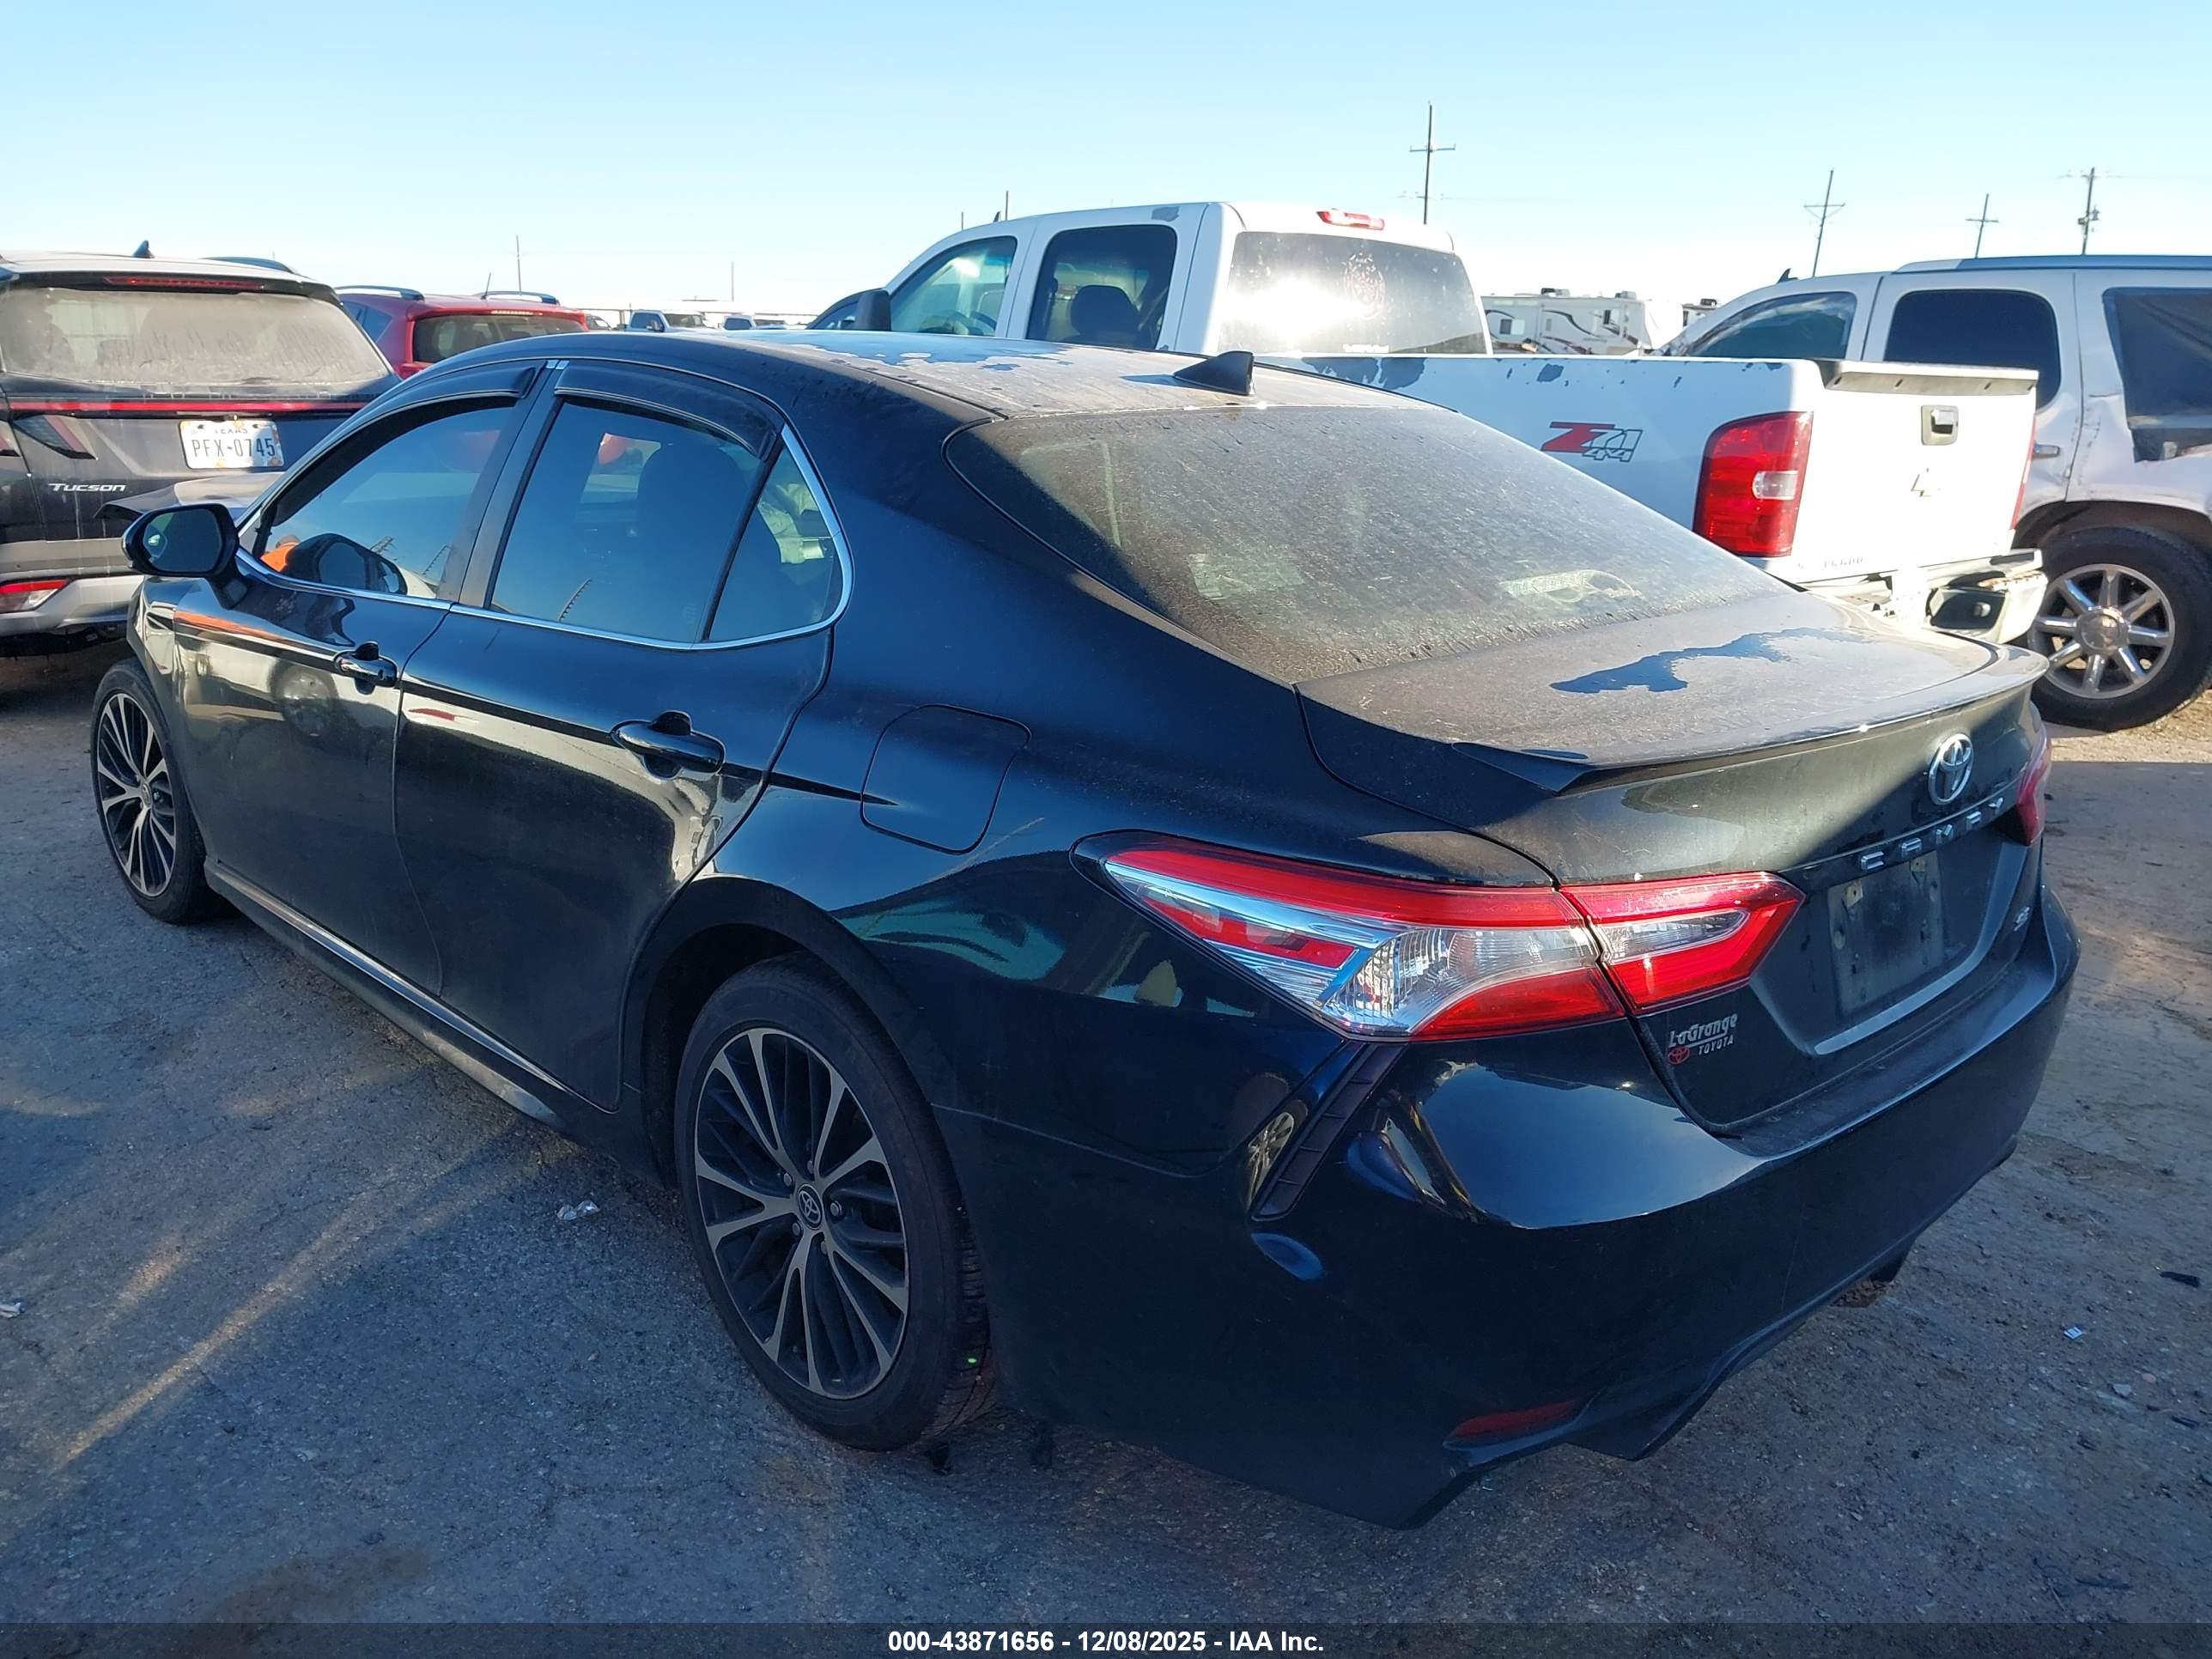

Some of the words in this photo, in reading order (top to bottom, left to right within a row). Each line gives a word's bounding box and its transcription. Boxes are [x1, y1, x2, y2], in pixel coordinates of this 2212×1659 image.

[1540, 421, 1644, 453] Z71
[1668, 1013, 1738, 1048] LaGrange
[1698, 1034, 1734, 1055] TOYOTA
